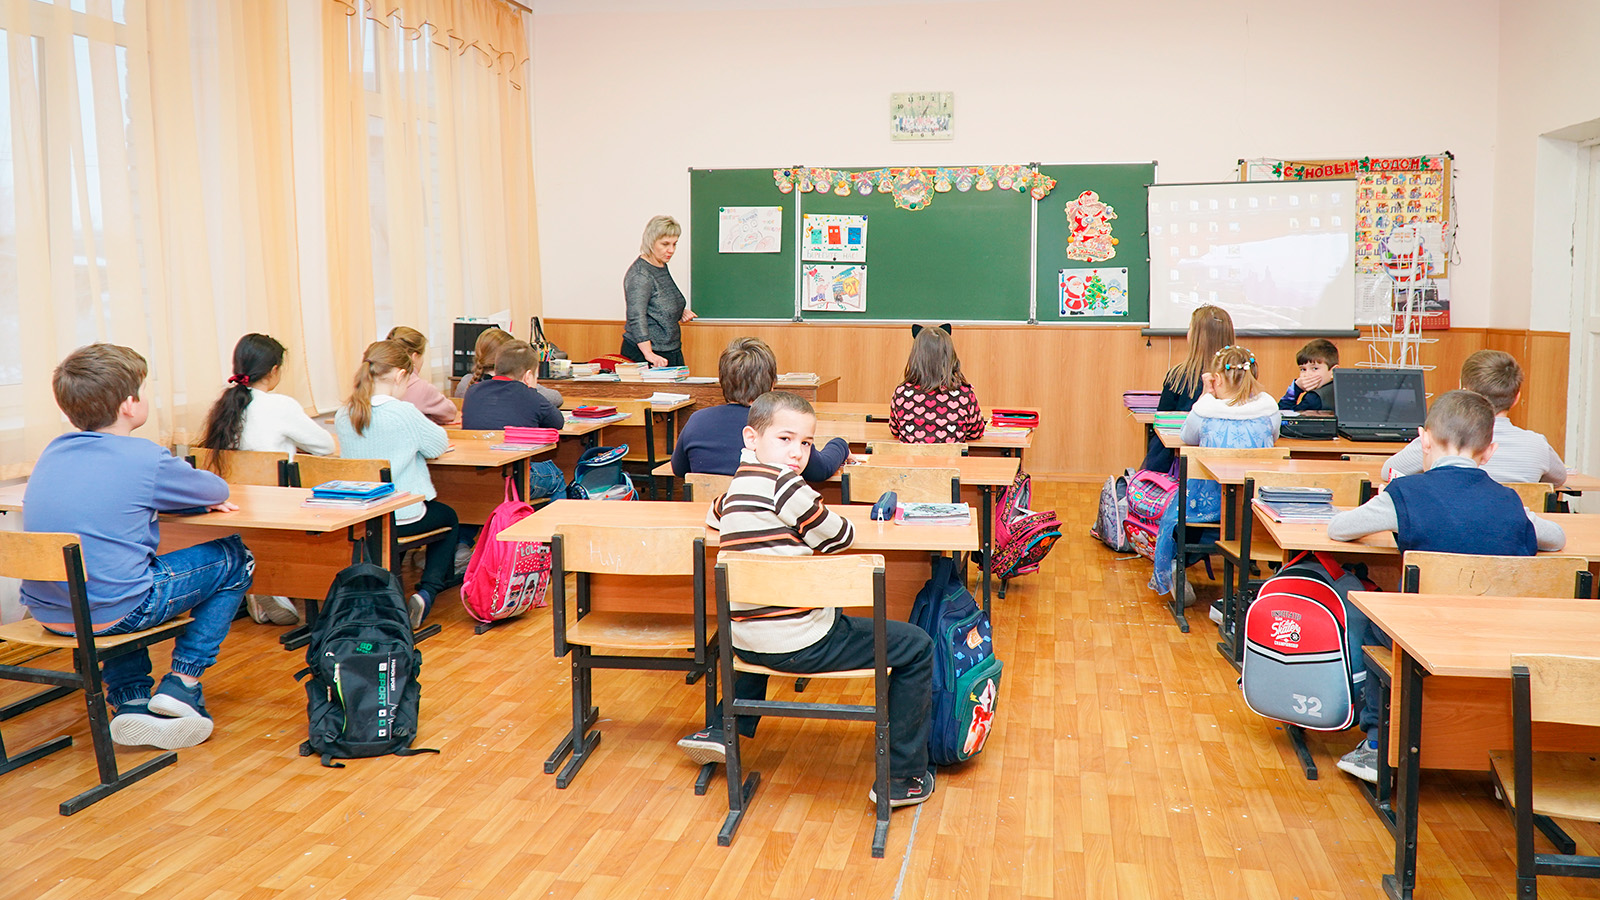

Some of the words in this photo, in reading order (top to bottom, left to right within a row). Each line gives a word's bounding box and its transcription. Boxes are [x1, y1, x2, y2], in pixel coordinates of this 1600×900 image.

[1283, 165, 1293, 177] С
[1305, 160, 1359, 179] НОВЫМ
[1370, 158, 1420, 171] ГОДОМ
[378, 672, 387, 707] SPORT
[1292, 693, 1323, 718] 32
